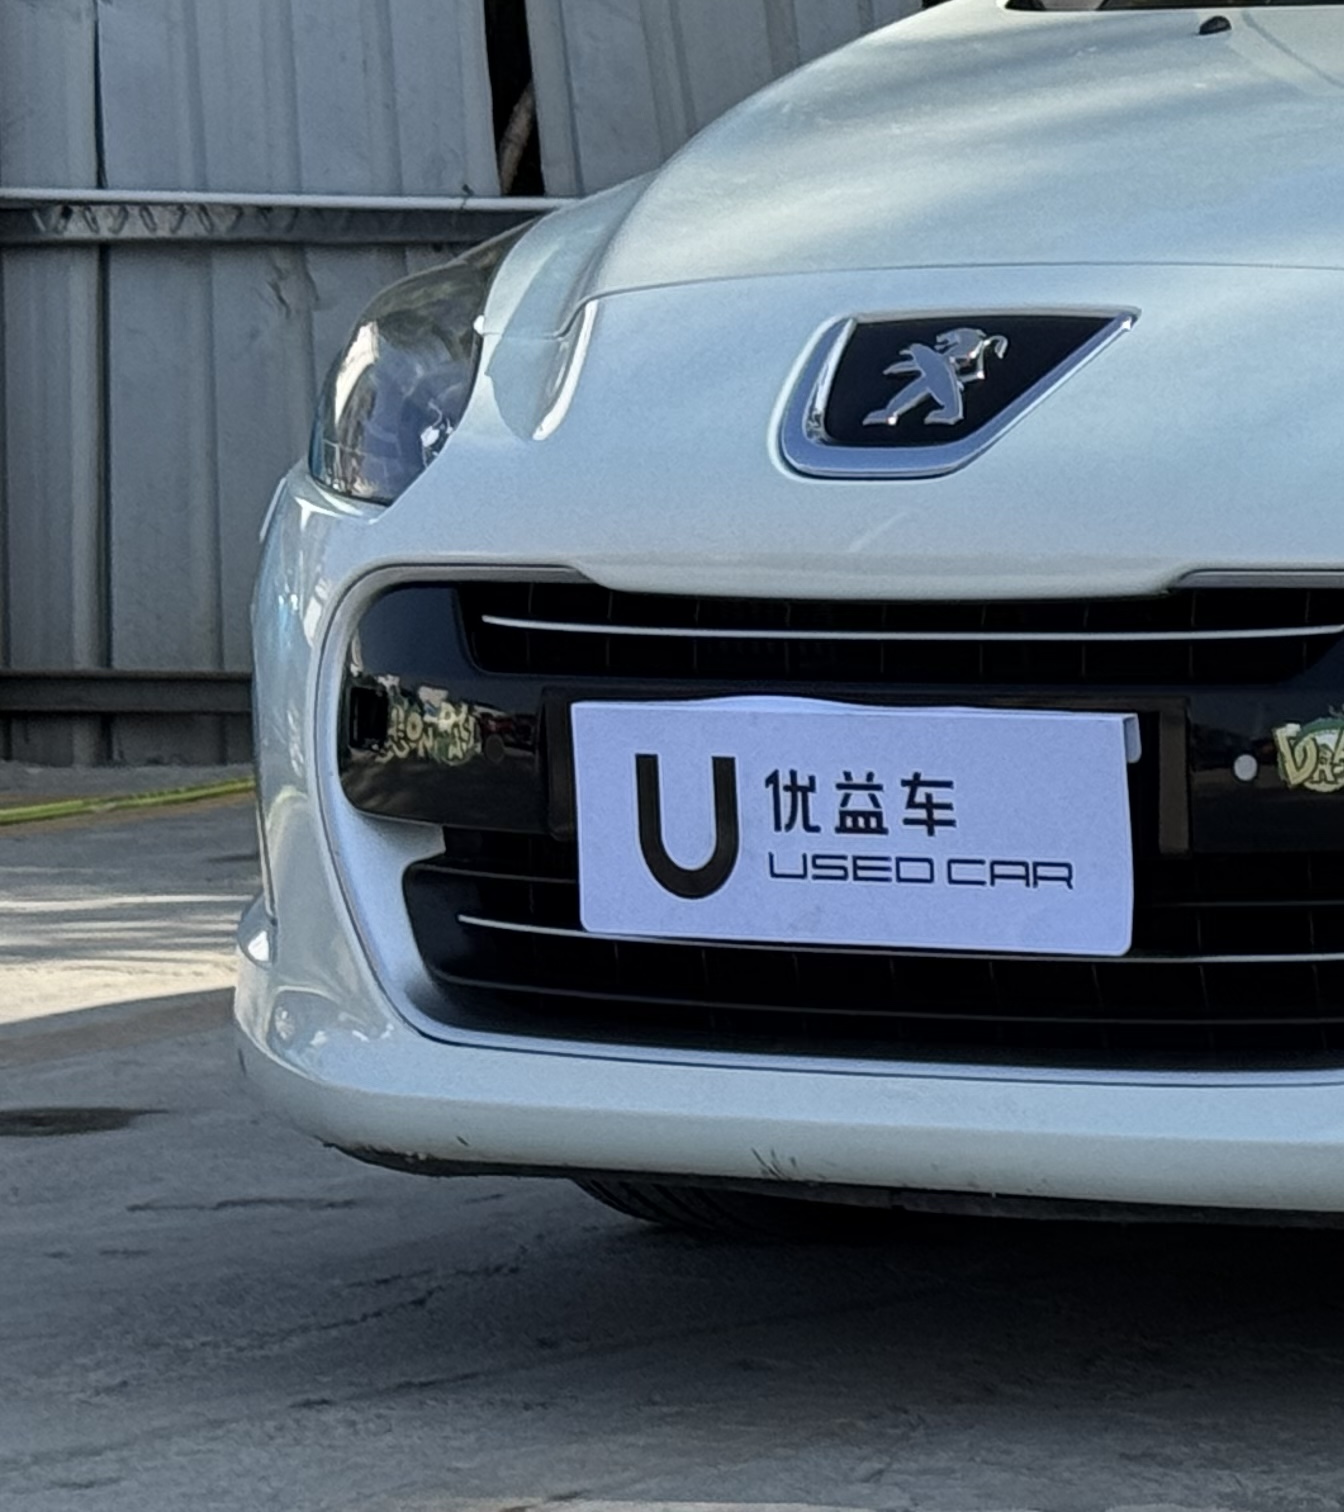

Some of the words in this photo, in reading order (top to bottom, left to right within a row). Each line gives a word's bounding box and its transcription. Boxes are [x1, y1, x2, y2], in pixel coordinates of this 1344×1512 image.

[635, 753, 739, 900] U
[765, 769, 957, 836] 优益车
[768, 852, 934, 884] USED
[947, 859, 1074, 890] CAR
